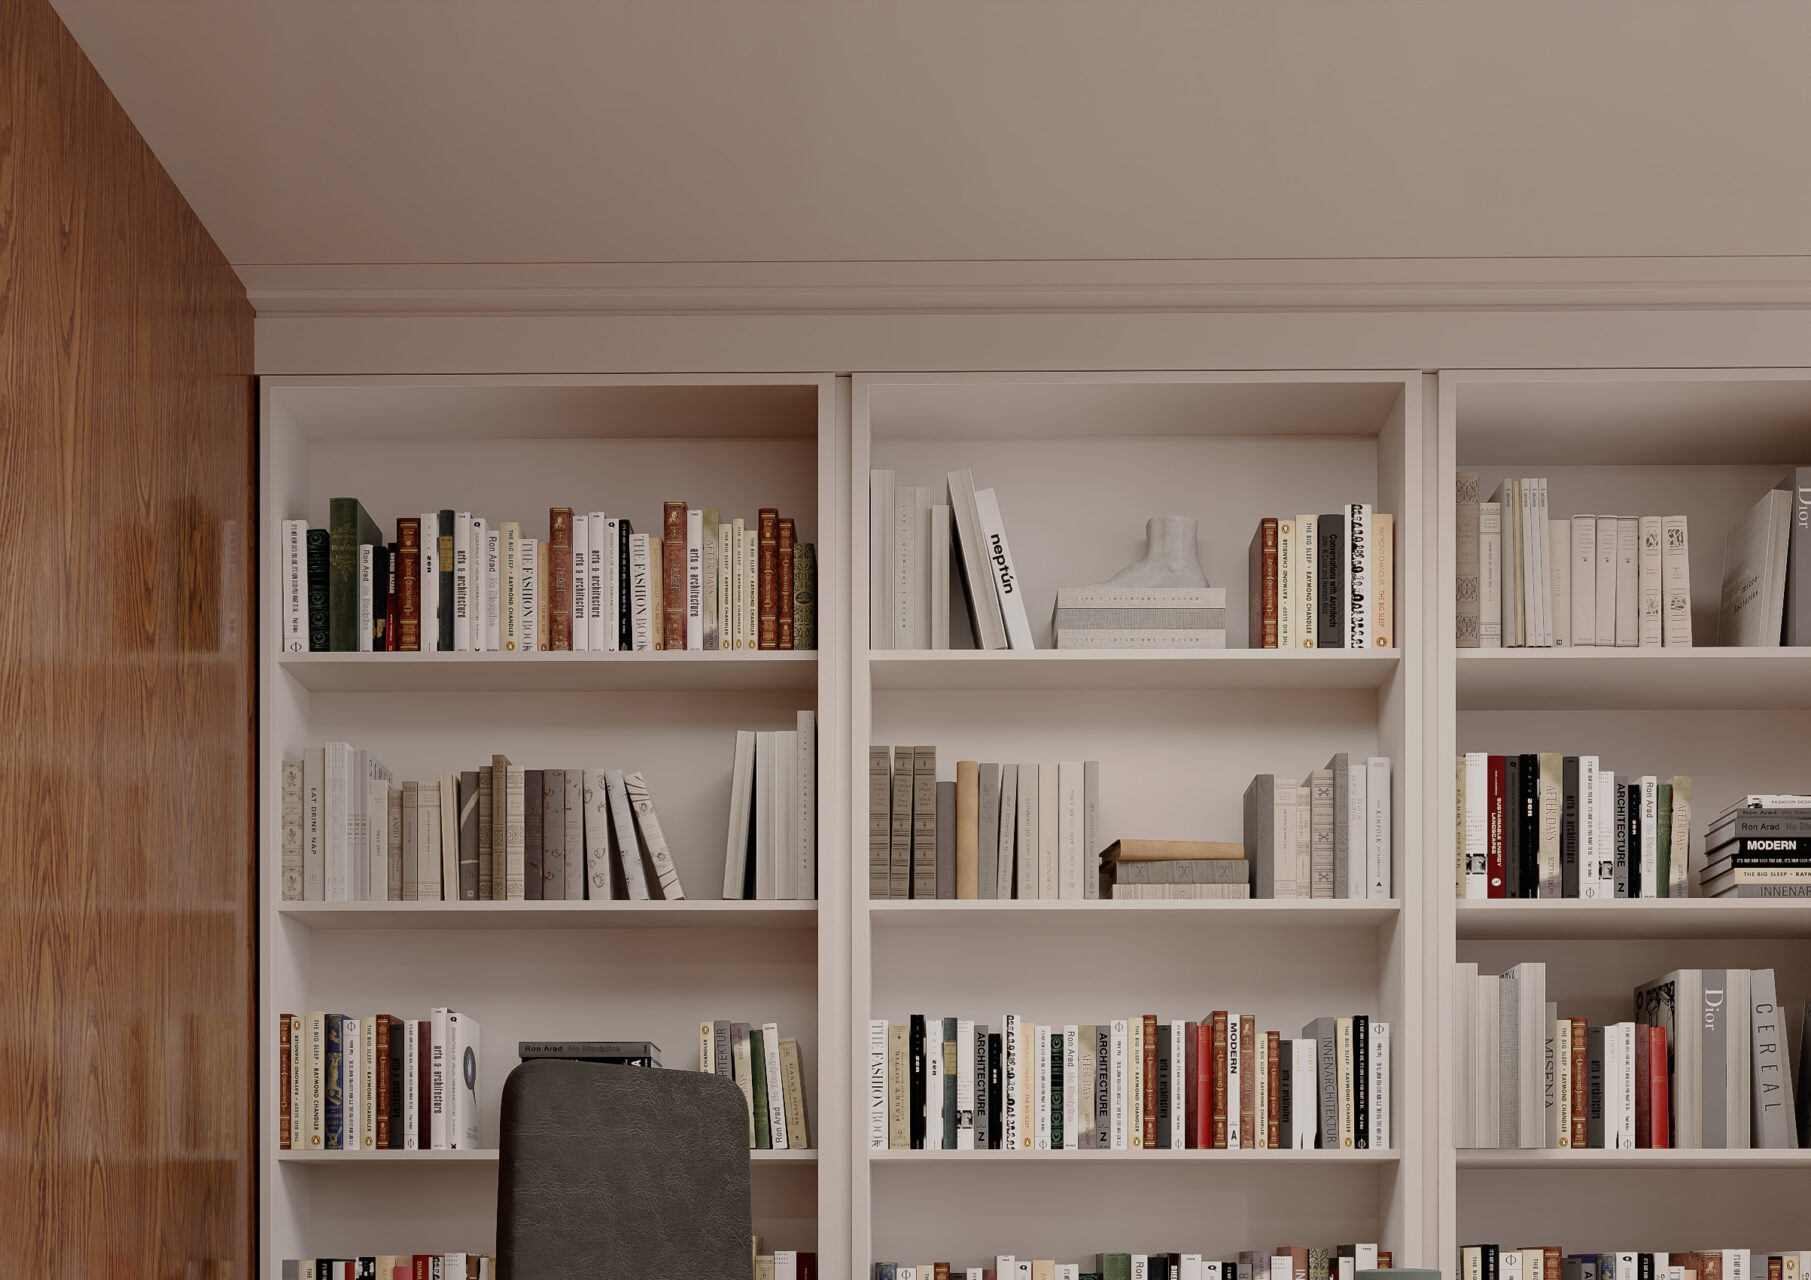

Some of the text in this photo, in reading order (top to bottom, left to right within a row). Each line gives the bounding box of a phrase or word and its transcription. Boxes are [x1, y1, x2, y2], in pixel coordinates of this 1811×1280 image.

[489, 537, 497, 572] Ron Arad
[991, 533, 1014, 594] neptún
[1329, 534, 1337, 628] Conversations with Architects
[522, 541, 533, 651] THE FASHION BOOK
[1546, 785, 1557, 841] AFTER DAYS
[1617, 784, 1625, 867] ARCHITECTURE
[1646, 782, 1654, 818] Ron Arad
[1747, 841, 1797, 850] MODERN
[1704, 987, 1724, 1031] Dior
[872, 1022, 884, 1147] THE FASHION BOOK
[977, 1032, 985, 1116] ARCHITECTURE
[1067, 1031, 1075, 1067] Ron Arad
[1100, 1033, 1108, 1116] ARCHITECTURE
[1756, 1003, 1781, 1111] CEREAL
[1323, 1037, 1337, 1143] INNENARCHITEKTUR
[1136, 1261, 1144, 1279] Ron
